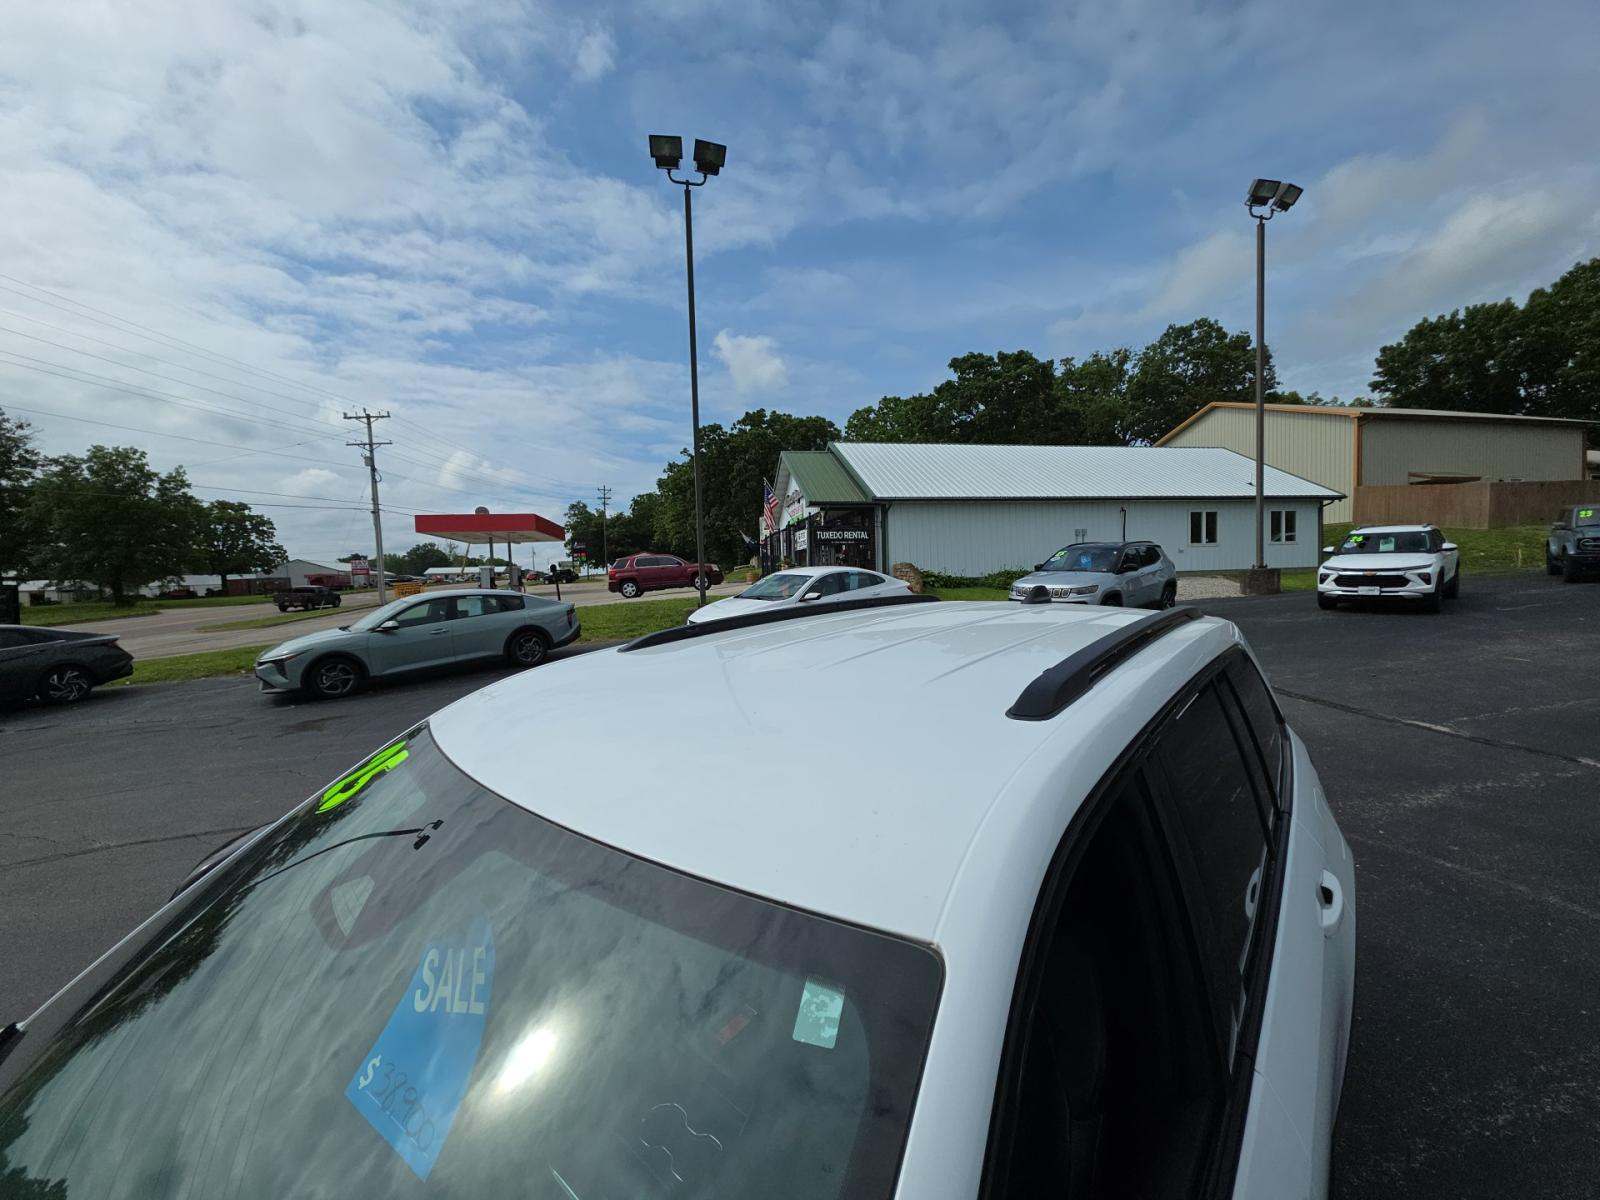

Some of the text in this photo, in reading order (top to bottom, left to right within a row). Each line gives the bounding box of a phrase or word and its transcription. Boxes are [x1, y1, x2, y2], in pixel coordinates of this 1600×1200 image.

[816, 531, 843, 540] TUXEDO
[843, 531, 869, 540] RENTAL
[414, 947, 486, 1015] SALE
